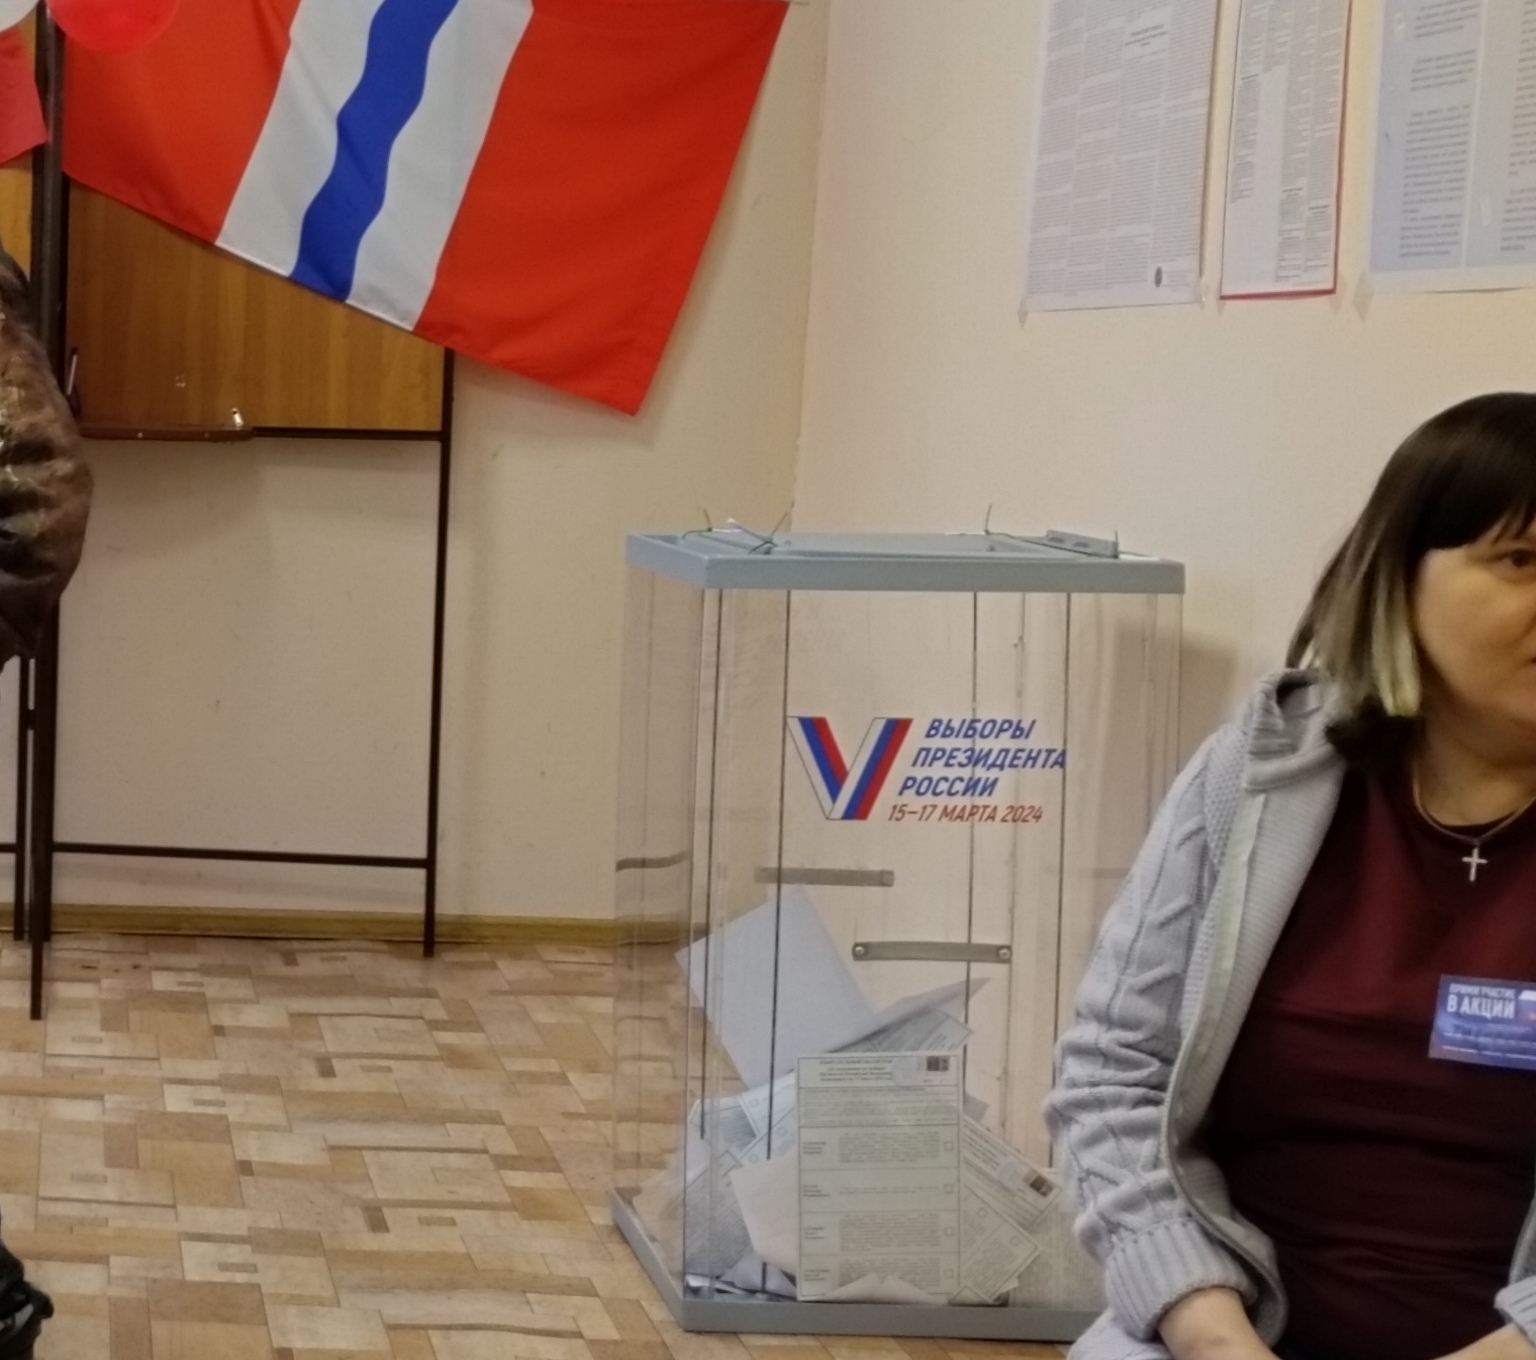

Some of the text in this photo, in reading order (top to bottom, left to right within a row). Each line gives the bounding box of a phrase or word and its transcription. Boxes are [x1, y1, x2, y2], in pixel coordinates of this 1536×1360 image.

[924, 718, 1037, 739] ВЫБОРЫ
[911, 747, 1066, 772] ПРЕЗИДЕНТА
[898, 776, 999, 797] РОССИИ
[938, 804, 998, 823] МАРТА
[1000, 805, 1044, 823] 2024
[1460, 996, 1515, 1019] АКЦИИ
